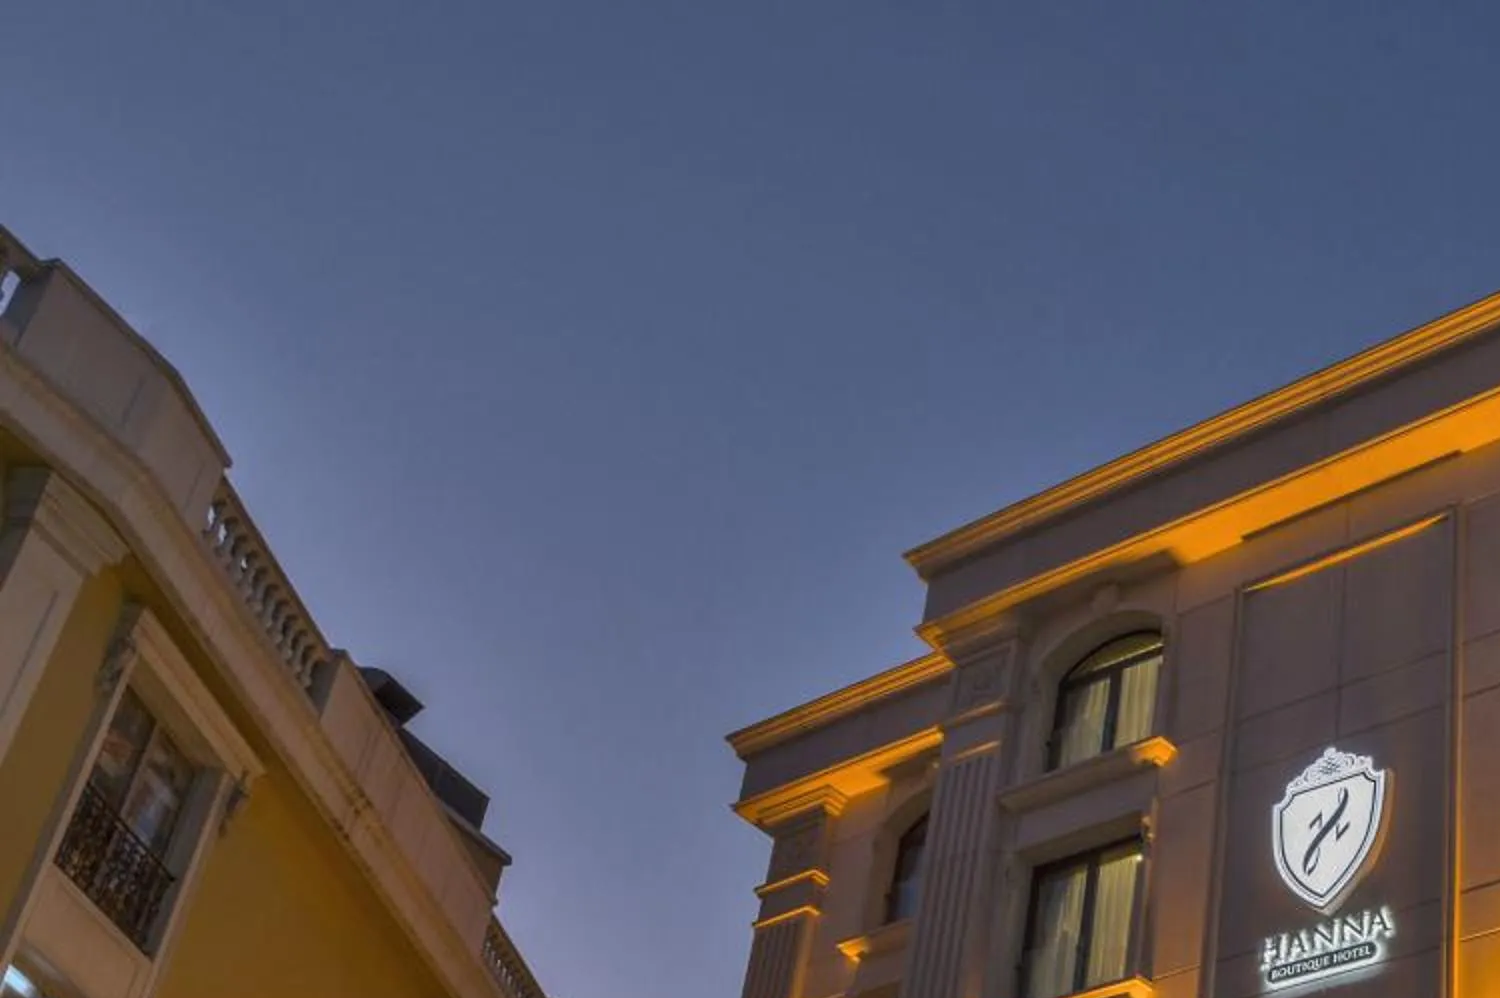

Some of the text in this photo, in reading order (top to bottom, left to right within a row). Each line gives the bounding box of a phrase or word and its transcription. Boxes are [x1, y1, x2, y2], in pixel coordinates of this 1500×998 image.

[1262, 905, 1394, 967] HANNA
[1271, 944, 1371, 980] BOUTIQUE HOTEL
